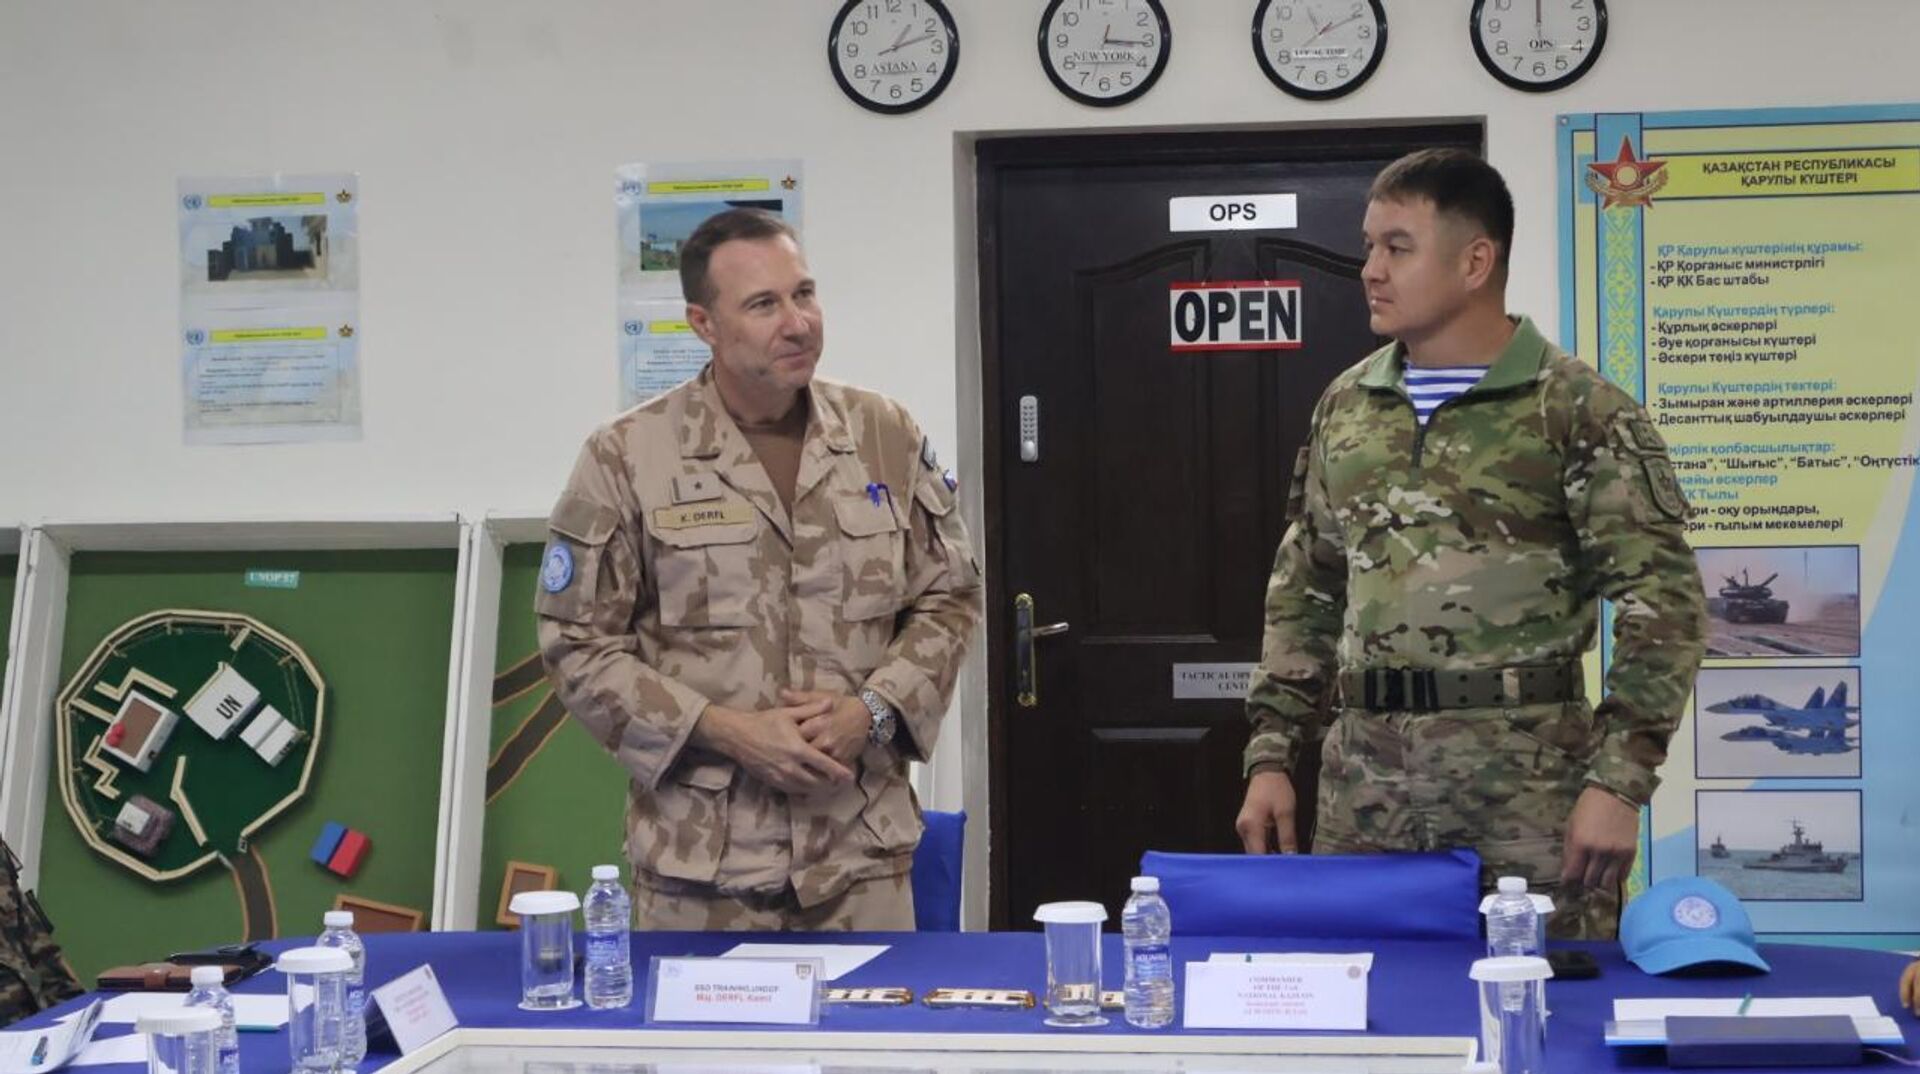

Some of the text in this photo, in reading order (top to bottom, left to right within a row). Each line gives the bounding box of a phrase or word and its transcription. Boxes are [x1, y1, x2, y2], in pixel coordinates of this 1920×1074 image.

[867, 5, 878, 19] 11
[885, 0, 901, 12] 12
[1276, 6, 1292, 20] 10
[1350, 3, 1363, 19] 2
[925, 18, 937, 32] 2
[1062, 12, 1079, 26] 10
[1136, 12, 1149, 26] 2
[1577, 16, 1590, 31] 3
[851, 20, 868, 36] 10
[1358, 25, 1370, 40] 3
[1488, 19, 1501, 34] 9
[1056, 34, 1068, 48] 9
[1142, 33, 1154, 48] 3
[1270, 28, 1284, 42] 9
[846, 43, 858, 58] 9
[931, 39, 944, 54] 3
[1496, 40, 1508, 55] 8
[1529, 40, 1554, 49] OPS
[1570, 39, 1583, 53] 4
[1074, 52, 1136, 61] NEW YORK
[1278, 50, 1291, 64] 8
[1351, 47, 1363, 61] 4
[872, 62, 918, 73] ASTANA
[926, 62, 937, 74] 4
[1063, 55, 1076, 70] 8
[1136, 56, 1148, 69] 4
[1513, 56, 1524, 70] 7
[1532, 62, 1546, 76] 6
[1556, 55, 1568, 70] 5
[854, 64, 866, 79] 8
[1294, 66, 1306, 80] 7
[1314, 70, 1328, 85] 6
[1336, 64, 1350, 78] 5
[911, 78, 923, 93] 5
[1078, 72, 1090, 86] 7
[1098, 77, 1110, 92] 6
[1120, 72, 1132, 86] 5
[870, 80, 881, 93] 7
[890, 84, 902, 98] 6
[1703, 158, 1896, 175] ҚАЗАҚСТАН РЕСПУБЛИКАСЫ
[1741, 172, 1858, 188] ҚАРУЛЫ КҮШТЕРІ
[1210, 203, 1256, 222] OPS
[1657, 261, 1674, 274] ҚР
[1677, 258, 1742, 273] Қорғаныс
[1745, 256, 1825, 271] министрлігі
[1657, 276, 1674, 289] ҚР
[1677, 275, 1694, 288] ҚК
[1696, 274, 1720, 286] Бас
[1724, 272, 1769, 286] штабы
[1175, 289, 1296, 342] OPEN
[1658, 321, 1710, 335] Құрлық
[1658, 337, 1684, 350] Әуе
[1685, 336, 1762, 350] қорғанысы
[1763, 334, 1816, 348] күштері
[1658, 352, 1706, 366] Әскери
[1744, 350, 1798, 363] күштері
[1658, 398, 1724, 411] Зымыран
[1726, 396, 1760, 408] және
[1762, 396, 1844, 410] артиллерия
[1658, 412, 1734, 426] Десанттық
[1718, 506, 1740, 517] оқу
[1766, 518, 1844, 532] мекемелері
[1182, 672, 1229, 680] TACTICAL
[216, 694, 242, 720] UN
